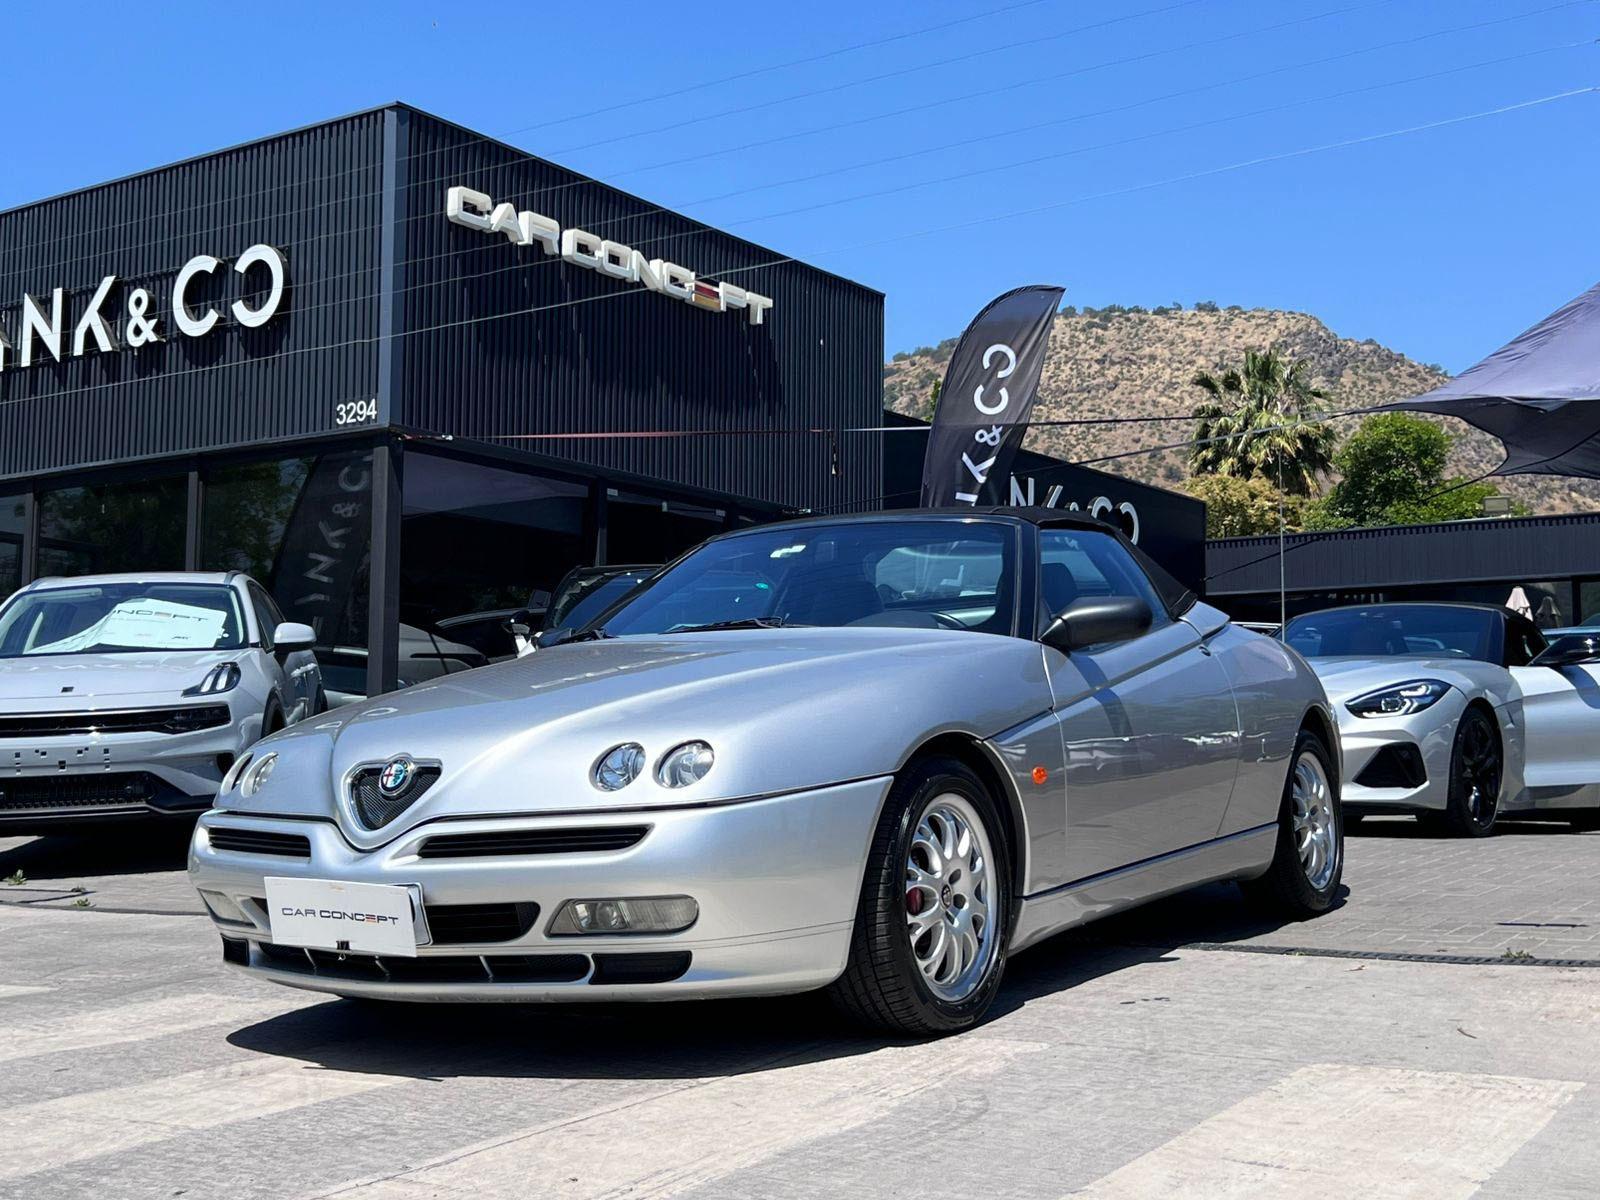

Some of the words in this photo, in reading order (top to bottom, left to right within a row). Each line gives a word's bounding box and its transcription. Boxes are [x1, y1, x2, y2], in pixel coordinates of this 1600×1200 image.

[0, 243, 285, 372] NK&CO
[336, 398, 377, 425] 3294
[114, 609, 209, 622] NCEPT
[281, 907, 316, 917] CAR
[319, 909, 399, 926] CONCEPT
